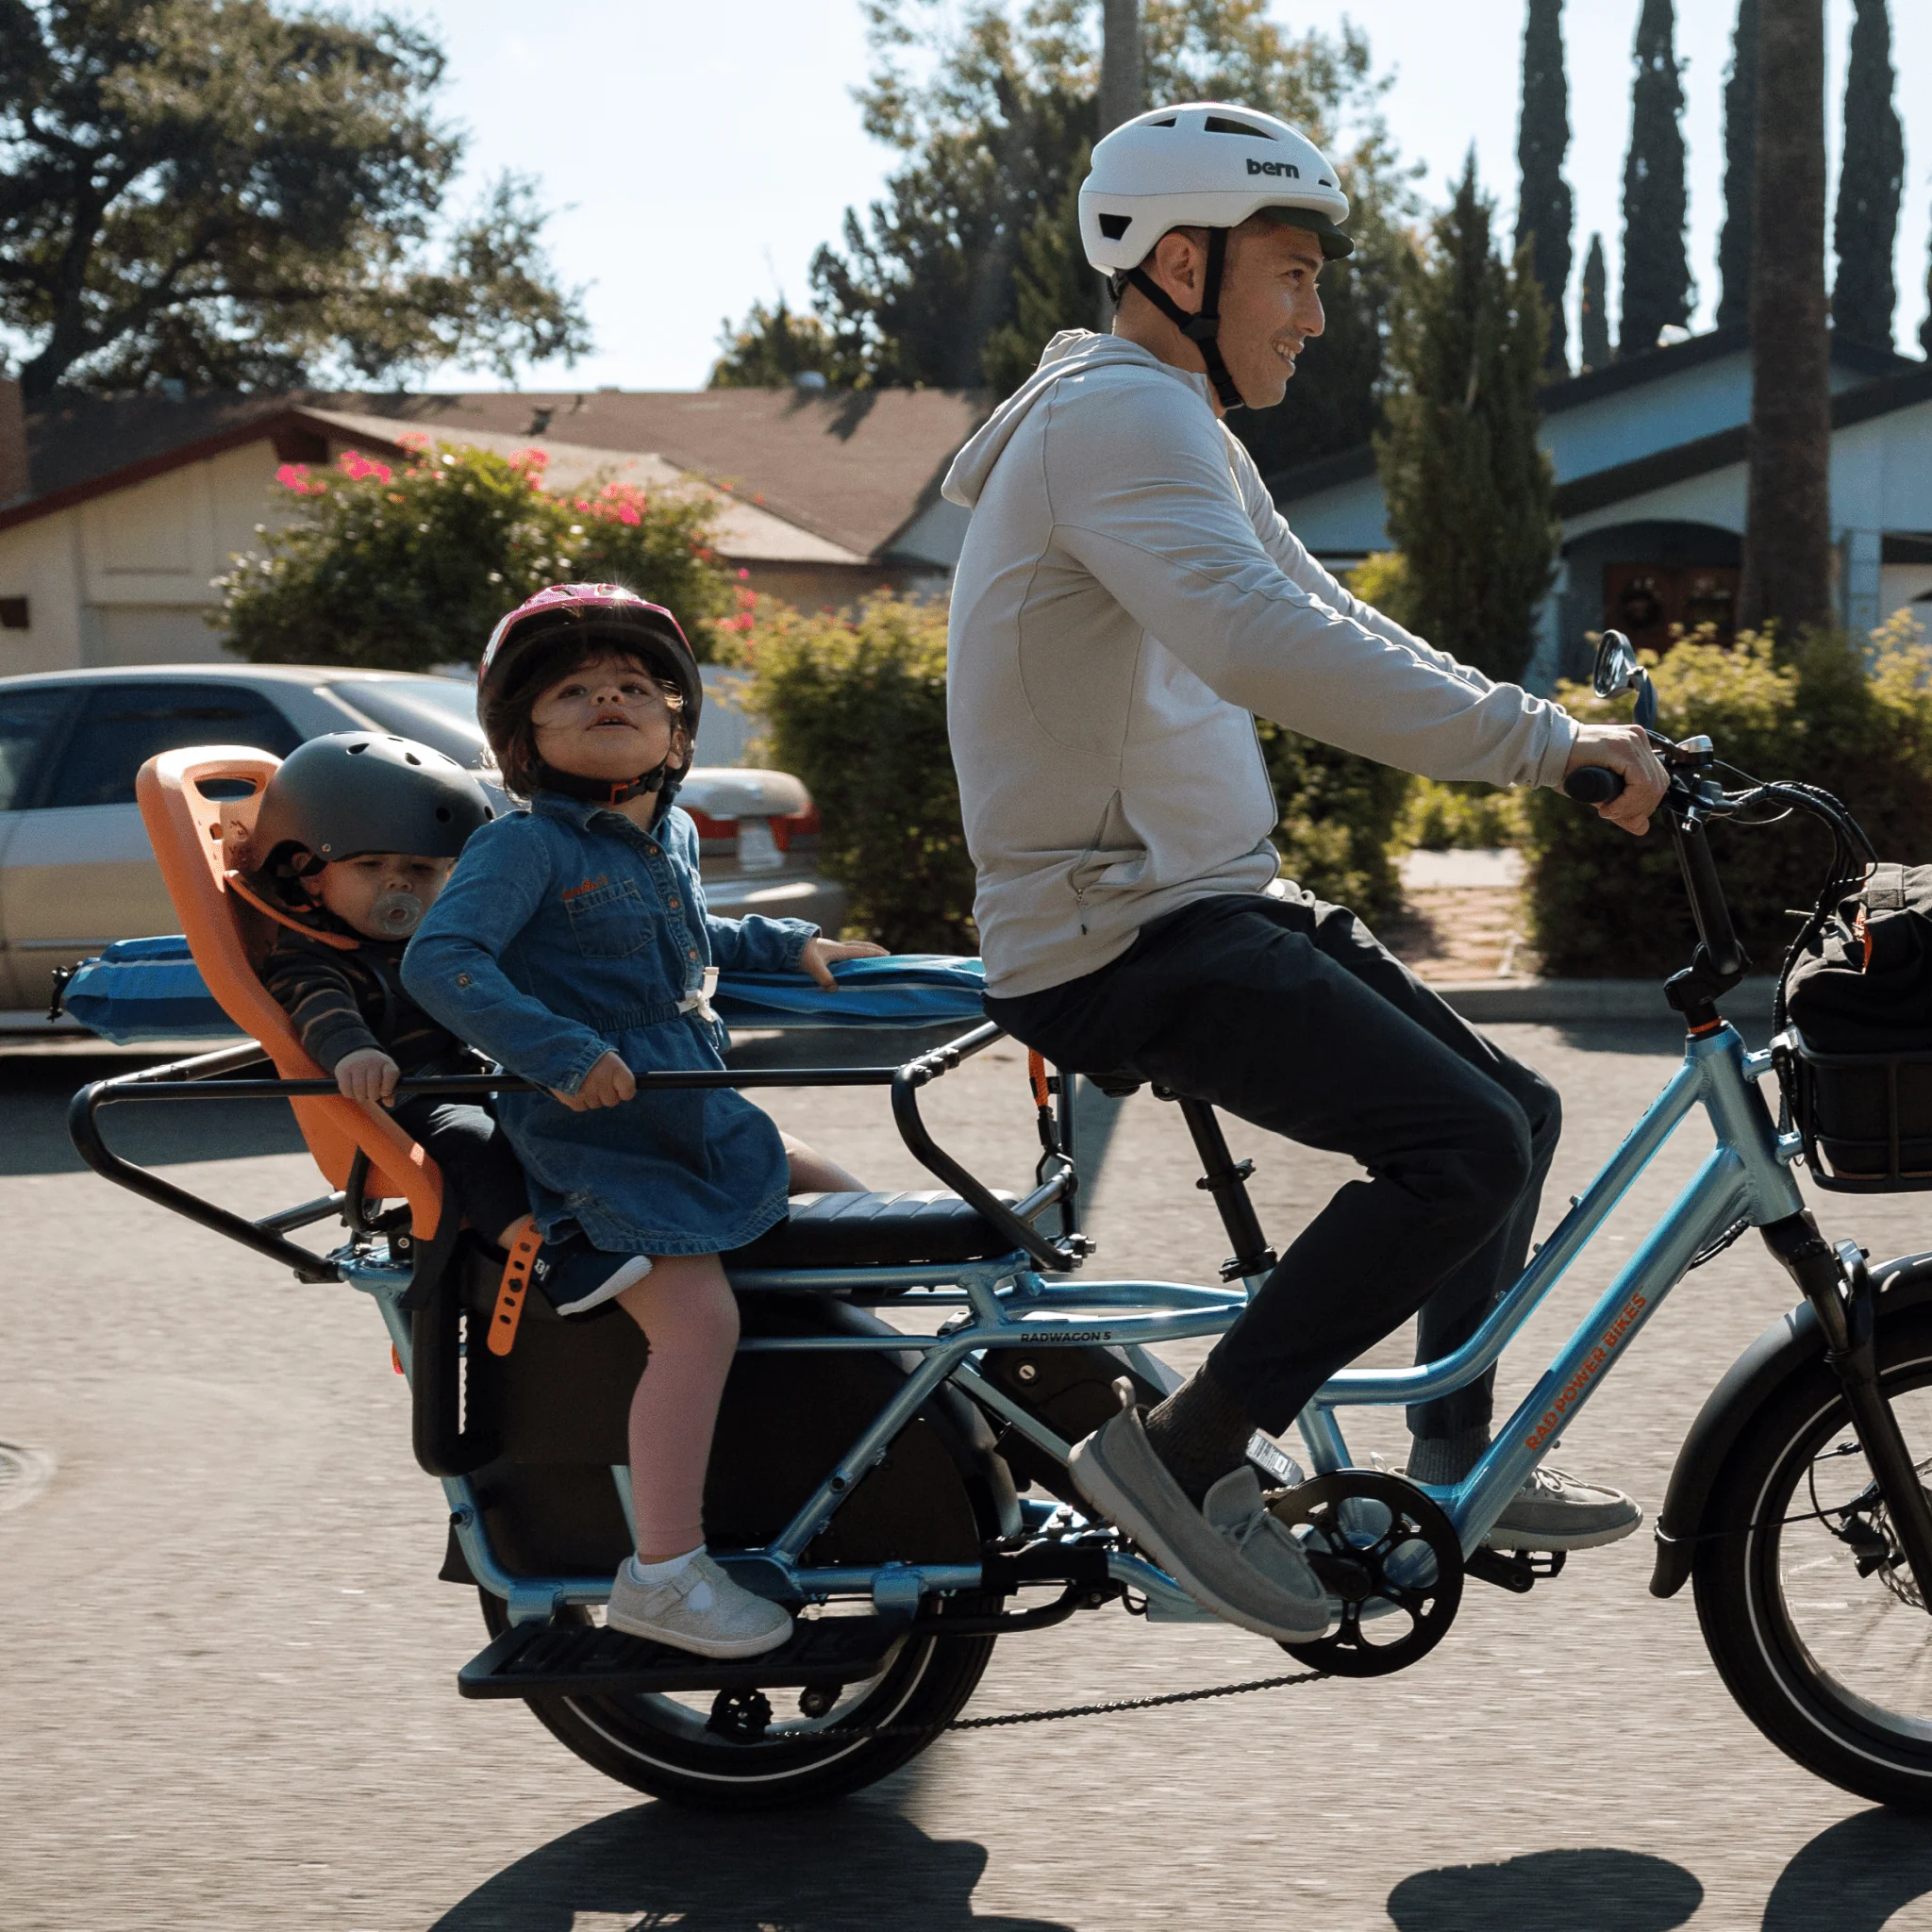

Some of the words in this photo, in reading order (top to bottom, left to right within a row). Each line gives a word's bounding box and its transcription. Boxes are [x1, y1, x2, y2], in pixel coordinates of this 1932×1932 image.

[1246, 158, 1300, 179] bern
[1021, 1331, 1101, 1342] RADWAGON
[1103, 1331, 1111, 1341] 5
[1524, 1411, 1559, 1452] RAD
[1554, 1346, 1607, 1414] POWER
[1602, 1291, 1647, 1348] BIKES
